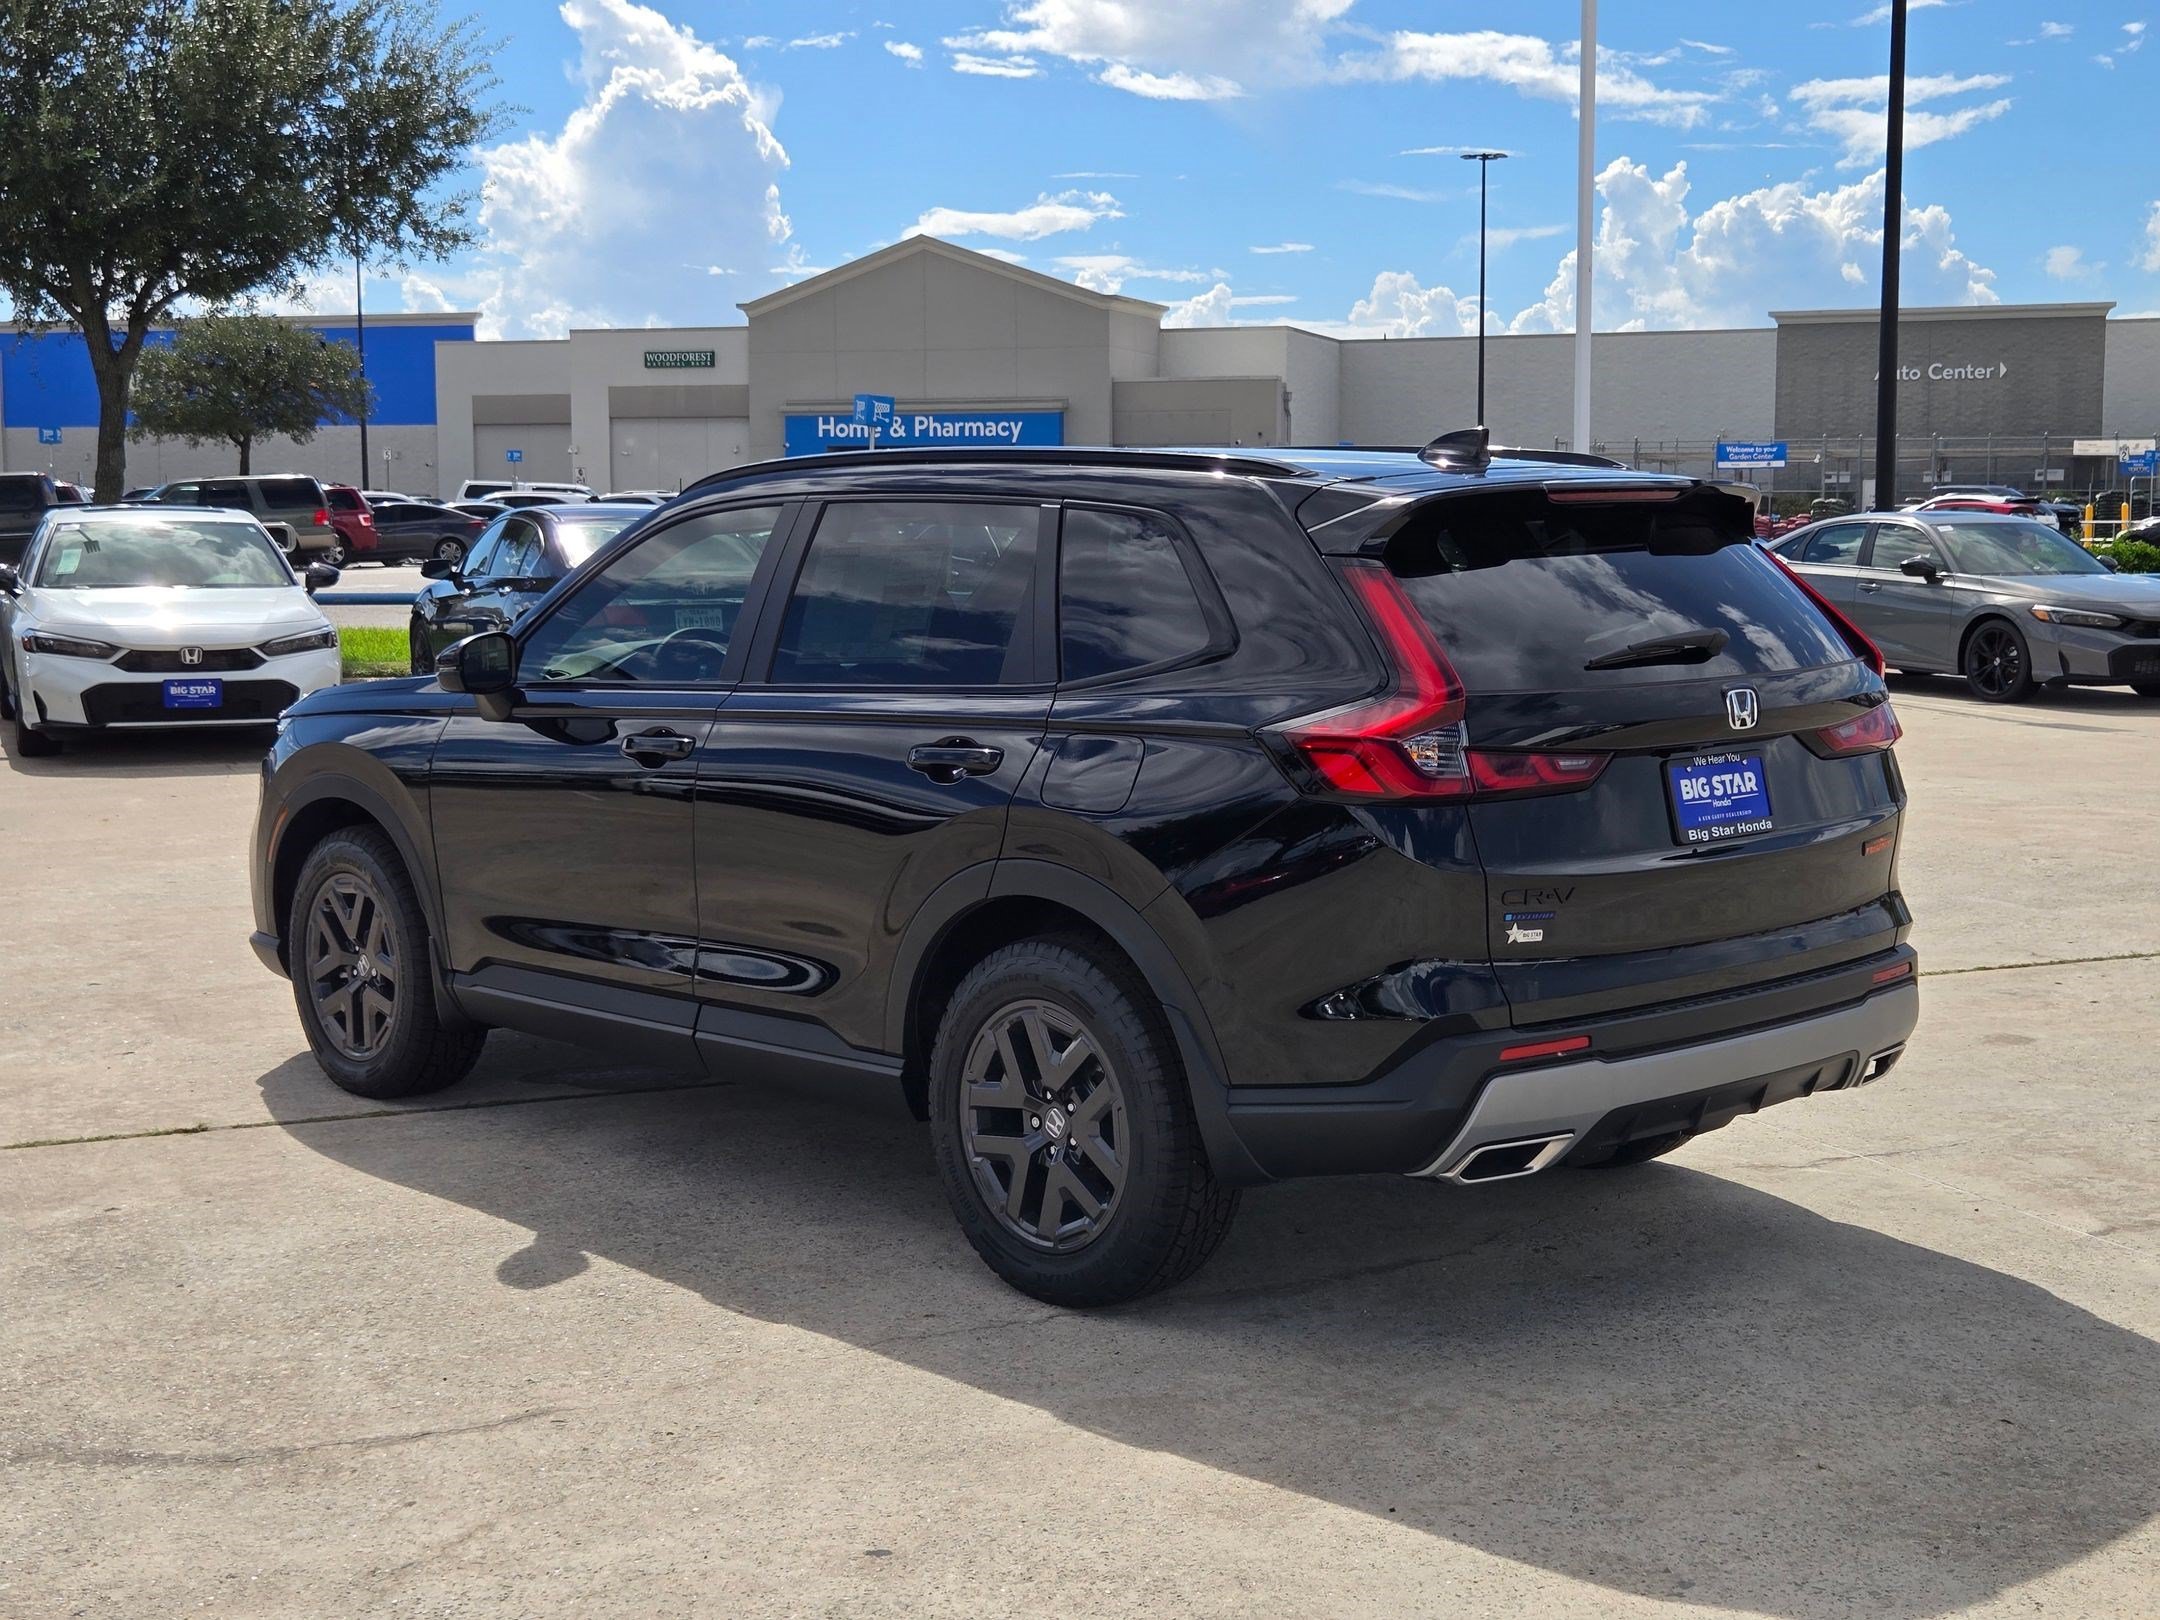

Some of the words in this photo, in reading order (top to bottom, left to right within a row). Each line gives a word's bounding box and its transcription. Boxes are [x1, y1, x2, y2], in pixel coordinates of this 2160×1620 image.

[646, 352, 712, 362] WOODFOREST
[1928, 363, 1995, 380] Center
[889, 416, 906, 438] &
[914, 416, 1023, 443] Pharmacy
[1764, 446, 1778, 454] your
[1729, 453, 1752, 461] Garden
[170, 686, 188, 694] BIG
[189, 686, 216, 694] STAR
[1693, 756, 1707, 767] We
[1707, 754, 1725, 765] Hear
[1726, 753, 1740, 763] You
[1680, 777, 1710, 800] BIG
[1712, 771, 1758, 796] STAR
[1713, 797, 1732, 808] Honda
[1688, 829, 1709, 841] Big
[1711, 825, 1735, 838] Star
[1737, 819, 1773, 834] Honda
